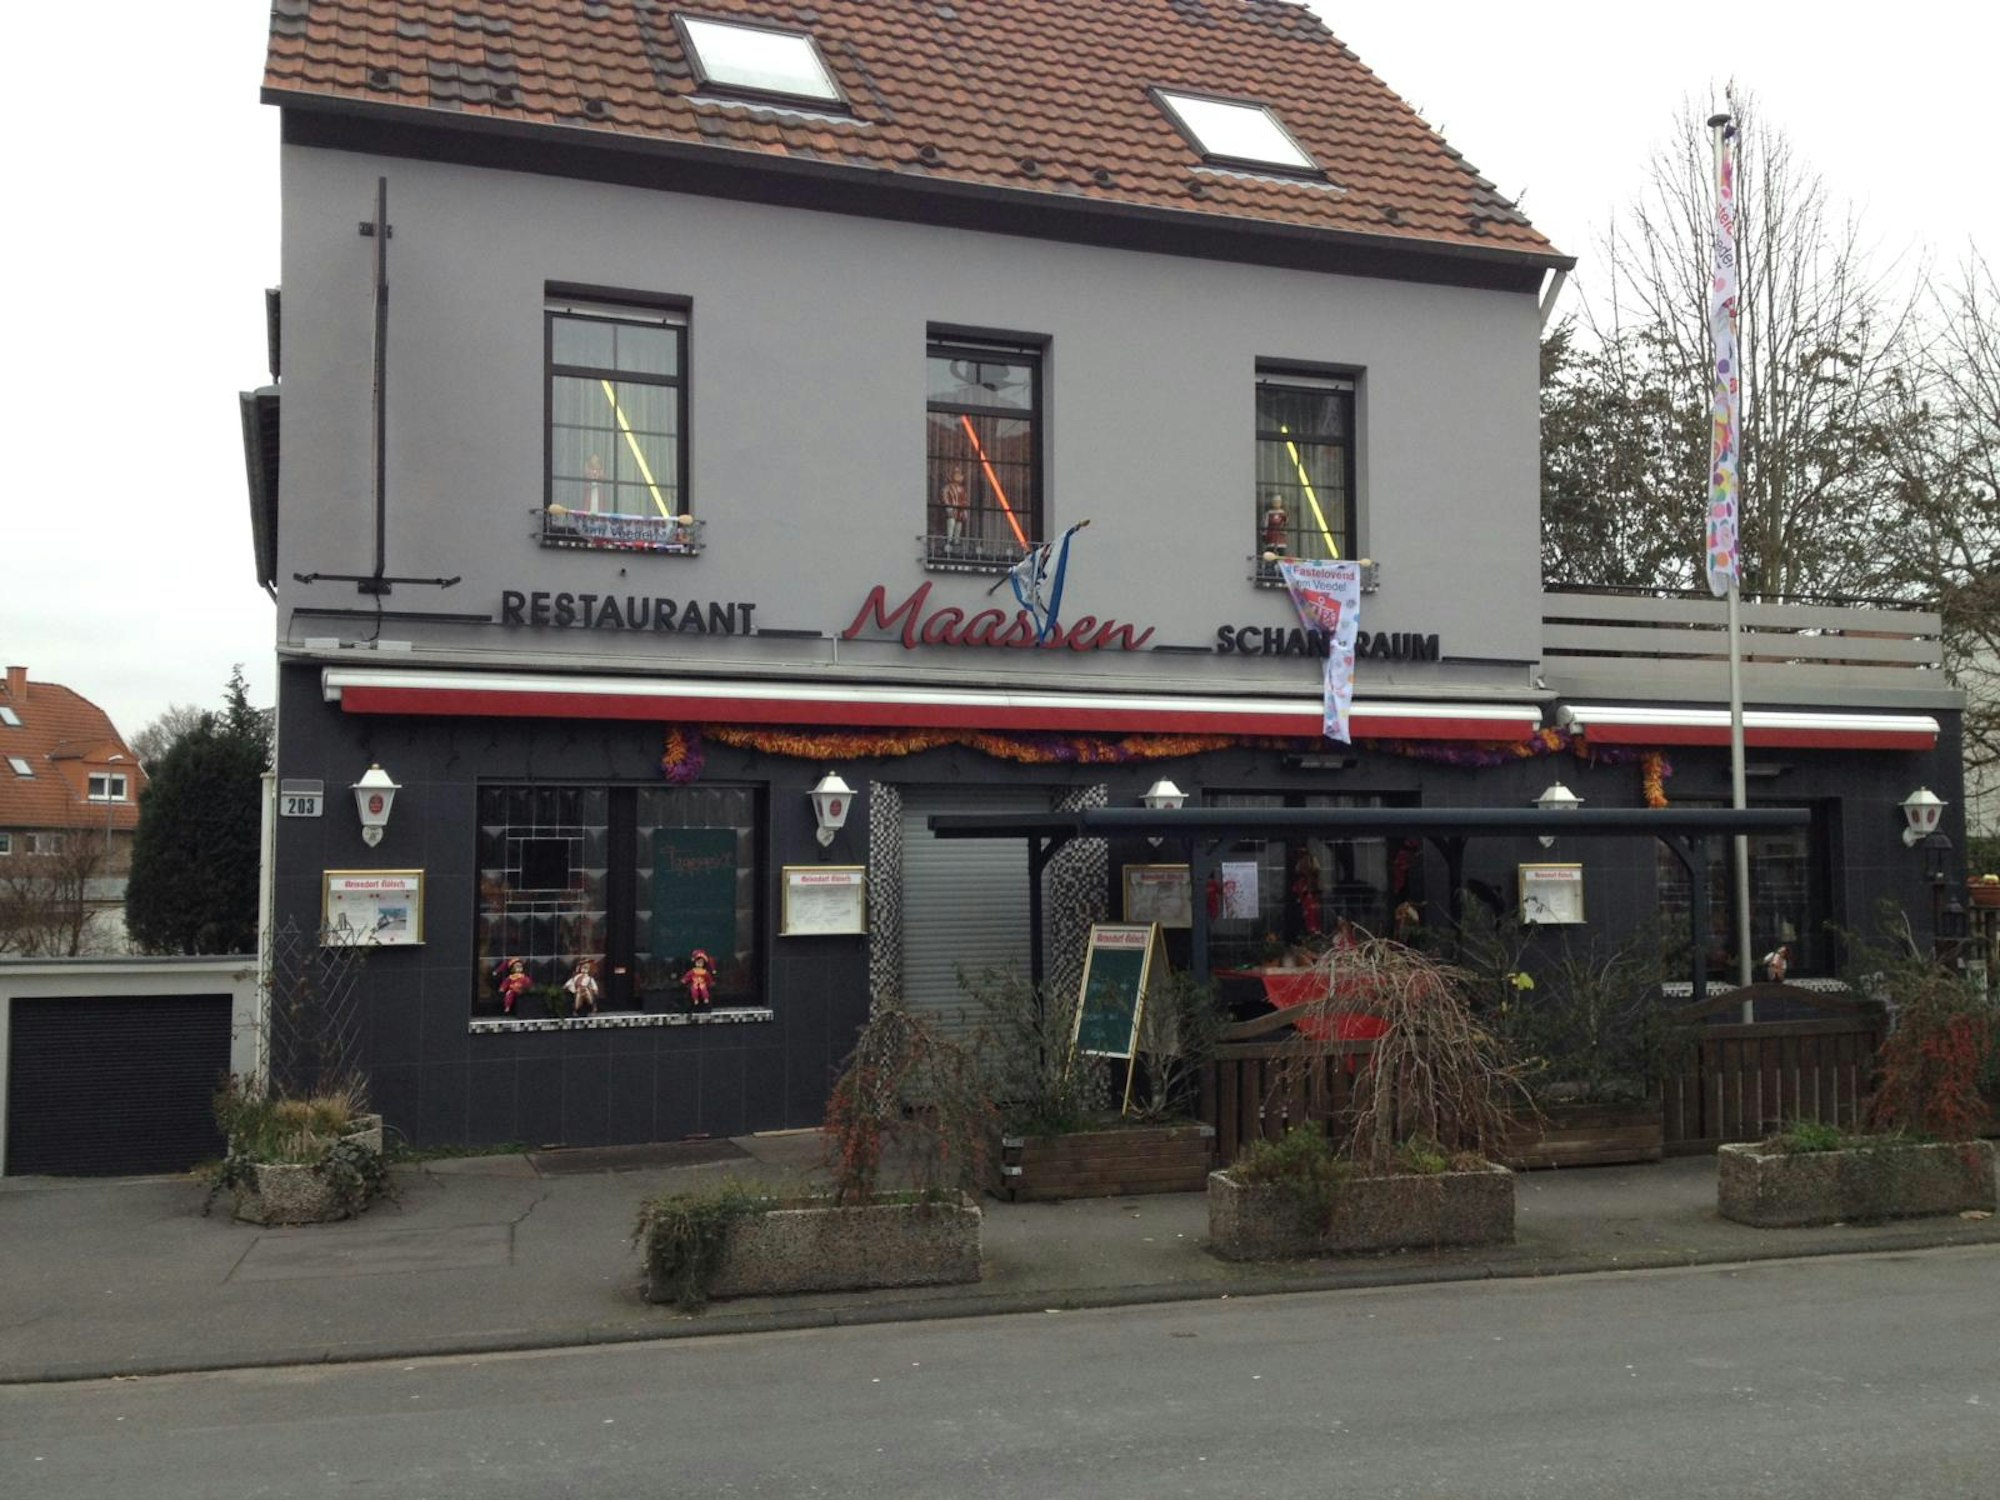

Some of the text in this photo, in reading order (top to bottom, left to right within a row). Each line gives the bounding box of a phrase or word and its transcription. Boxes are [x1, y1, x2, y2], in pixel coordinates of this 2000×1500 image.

[1294, 567, 1355, 581] Fastelovend
[1313, 580, 1347, 592] Veedel
[502, 590, 756, 636] RESTAURANT
[842, 580, 1155, 650] Maassen
[1216, 624, 1439, 661] SCHANRAUM
[288, 798, 314, 814] 203
